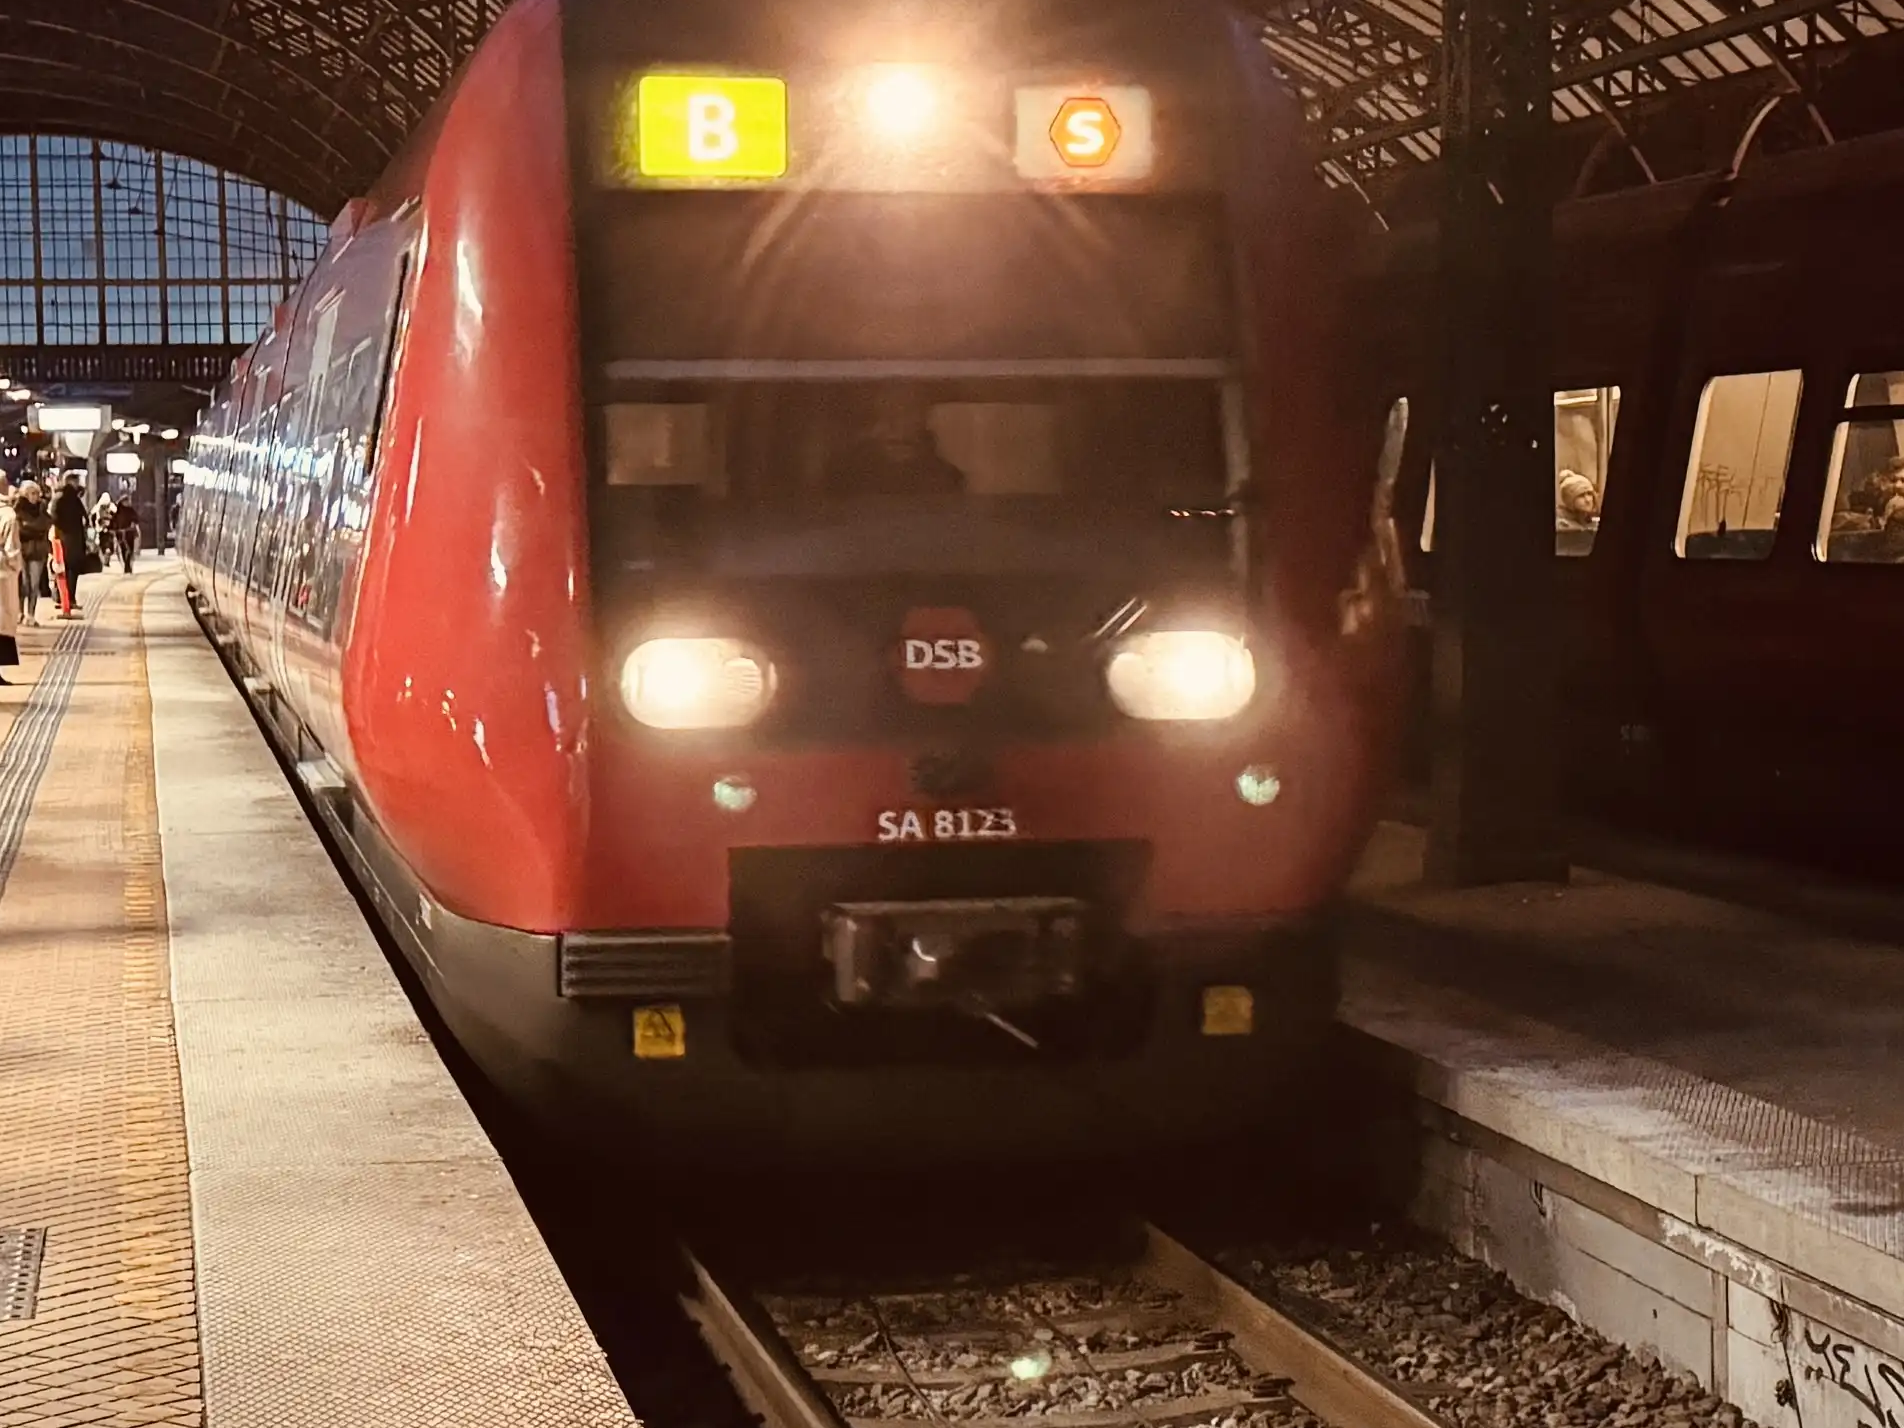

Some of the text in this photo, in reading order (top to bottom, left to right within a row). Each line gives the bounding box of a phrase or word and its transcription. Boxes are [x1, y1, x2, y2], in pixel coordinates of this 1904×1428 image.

[686, 94, 739, 162] B
[1064, 110, 1106, 154] S
[904, 638, 984, 669] DSB
[877, 809, 924, 842] SA
